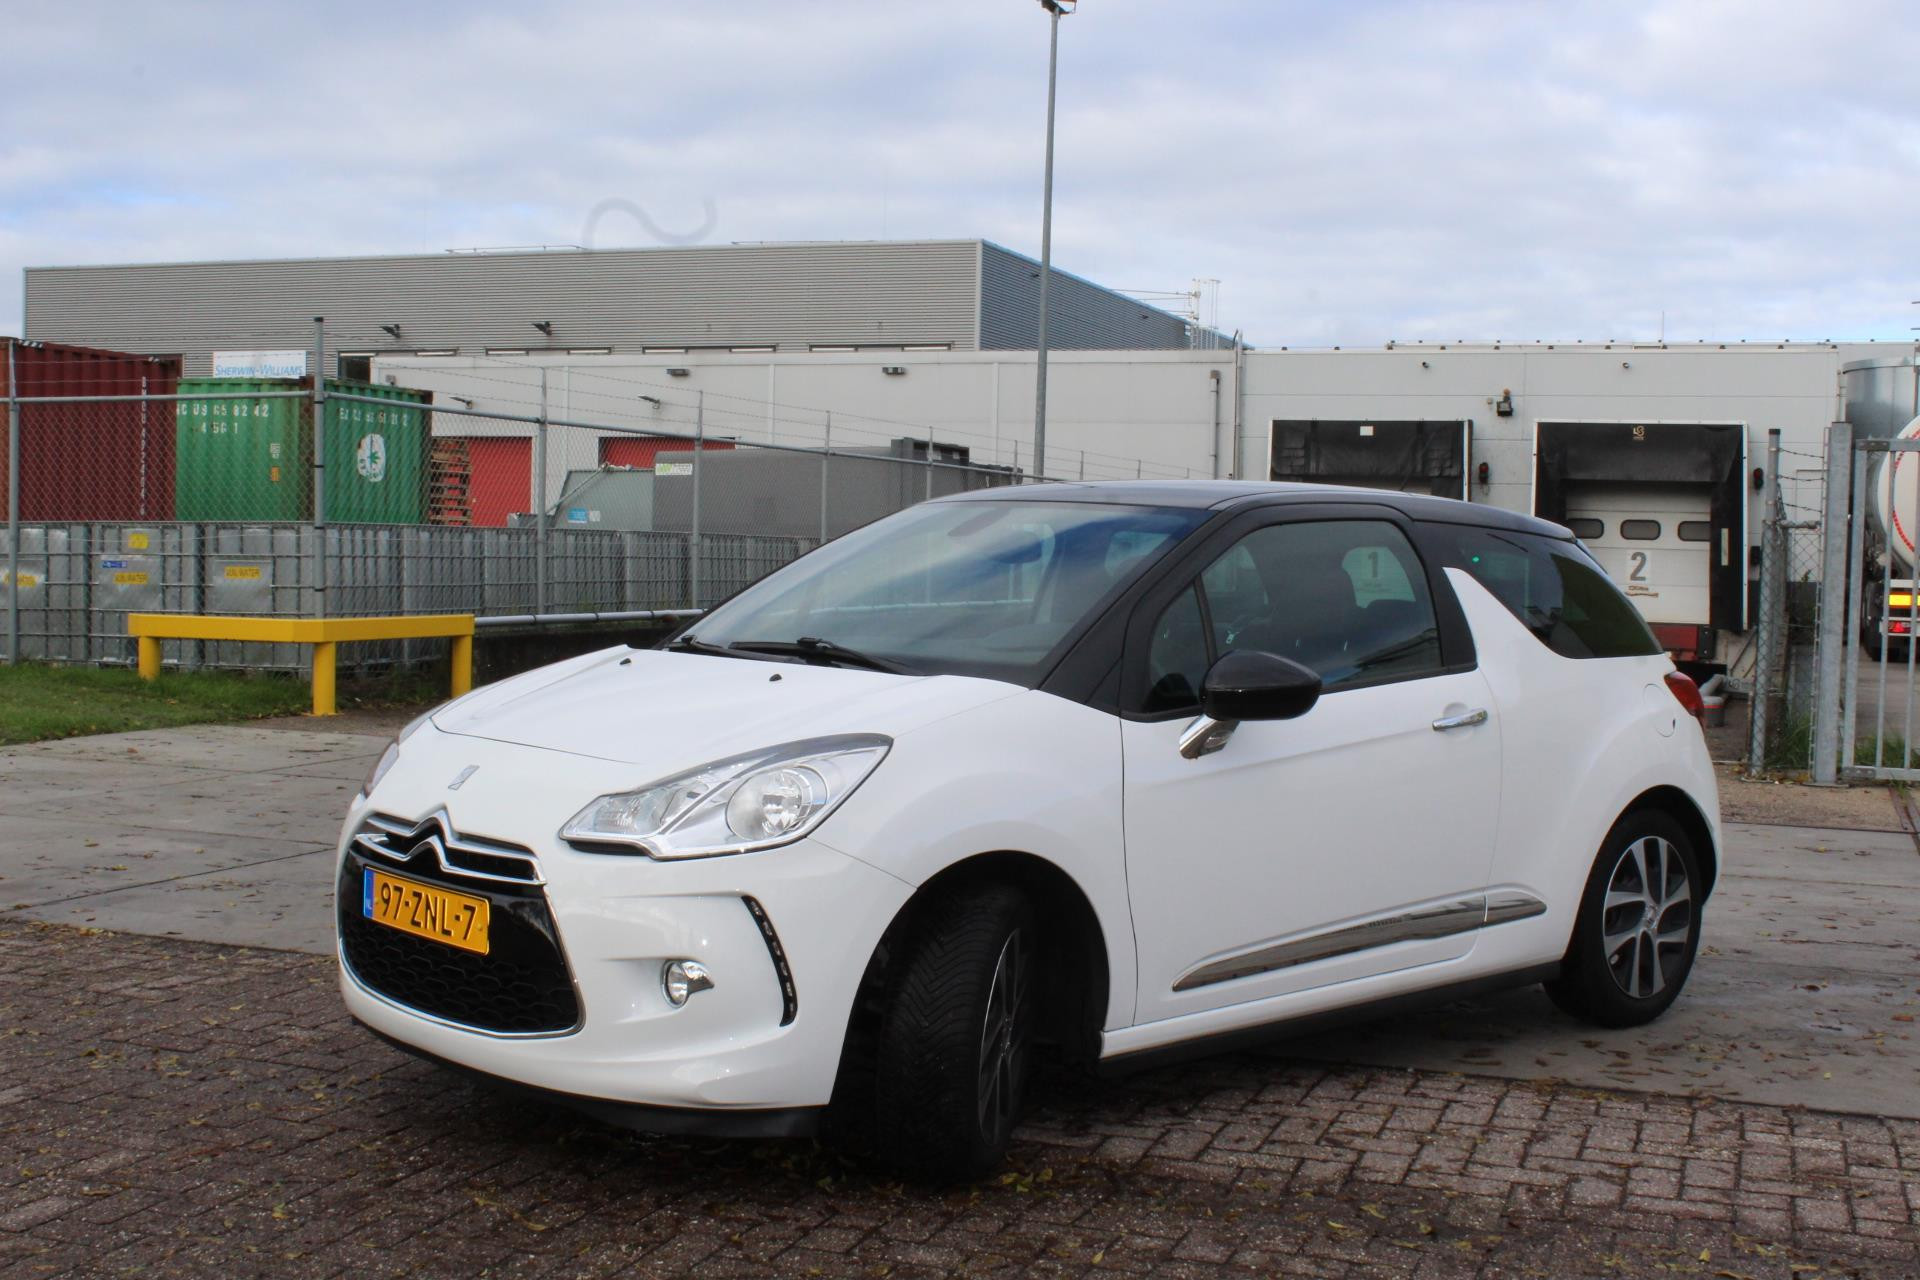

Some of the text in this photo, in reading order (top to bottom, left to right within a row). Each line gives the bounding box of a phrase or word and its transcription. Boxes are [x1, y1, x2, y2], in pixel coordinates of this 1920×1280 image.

[1368, 551, 1379, 578] 1
[1630, 551, 1647, 581] 2
[380, 881, 478, 941] 97-ZNL-7
